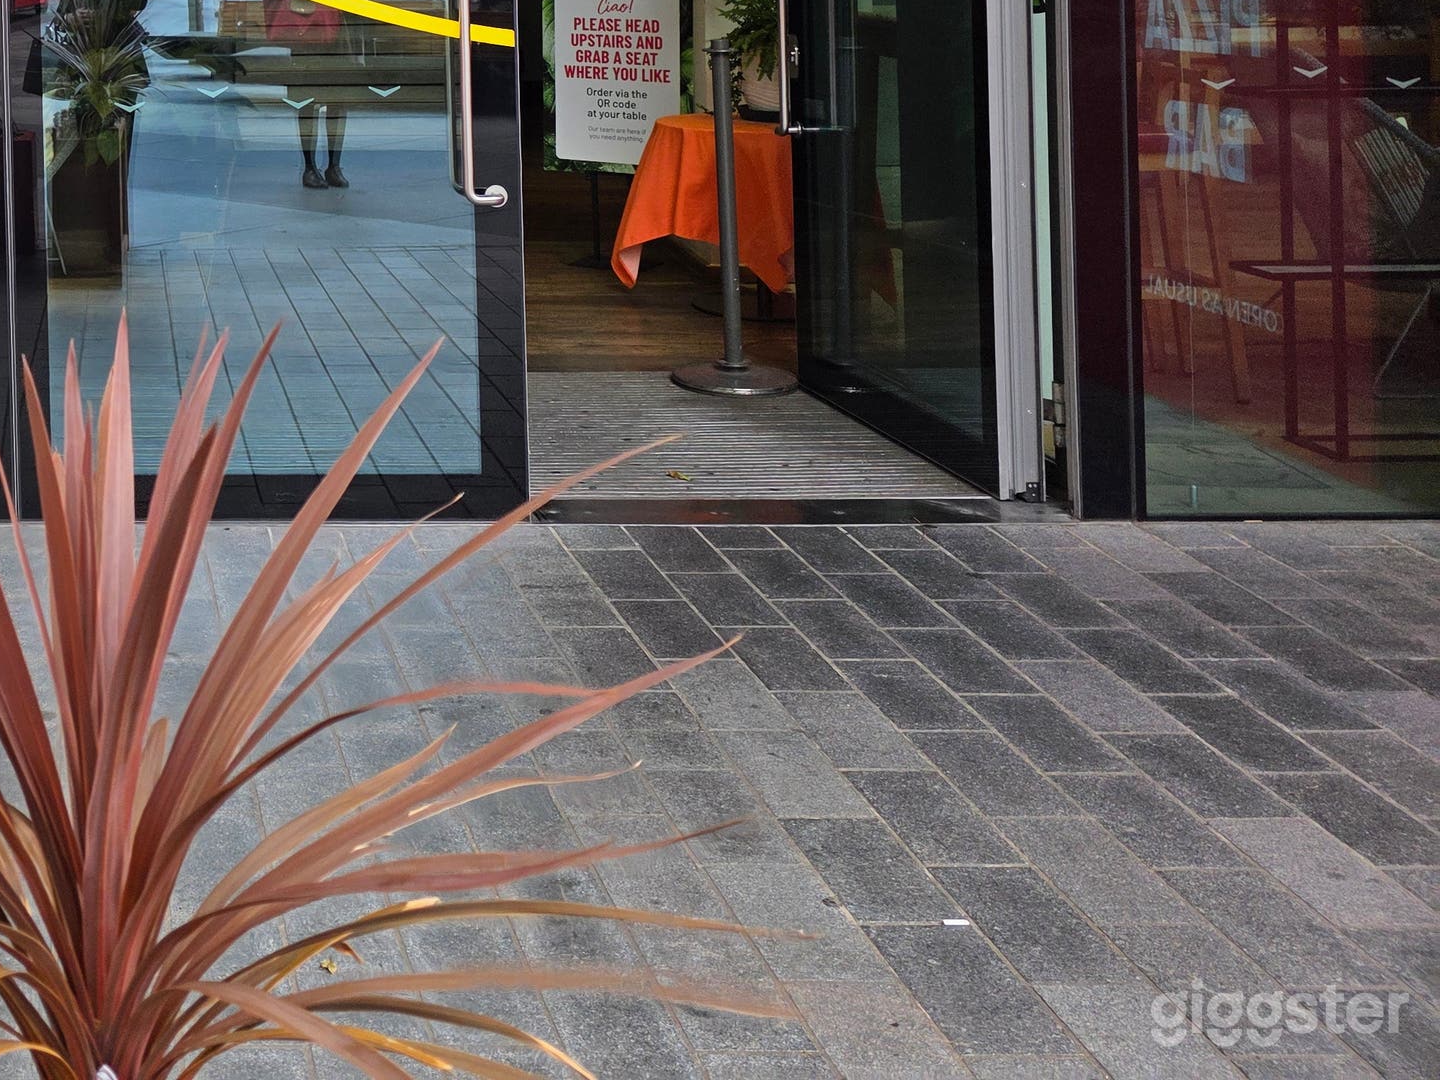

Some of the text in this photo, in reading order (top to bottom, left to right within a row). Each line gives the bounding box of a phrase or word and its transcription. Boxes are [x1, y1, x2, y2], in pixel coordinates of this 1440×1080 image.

[573, 17, 660, 33] PLEASE HEAD
[571, 33, 663, 50] UPSTAIRS AND
[575, 50, 658, 66] GRAB A SEAT
[564, 65, 671, 83] WHERE YOU LIKE
[586, 87, 647, 99] Order via the
[597, 99, 637, 109] QR code
[587, 110, 647, 120] at your table
